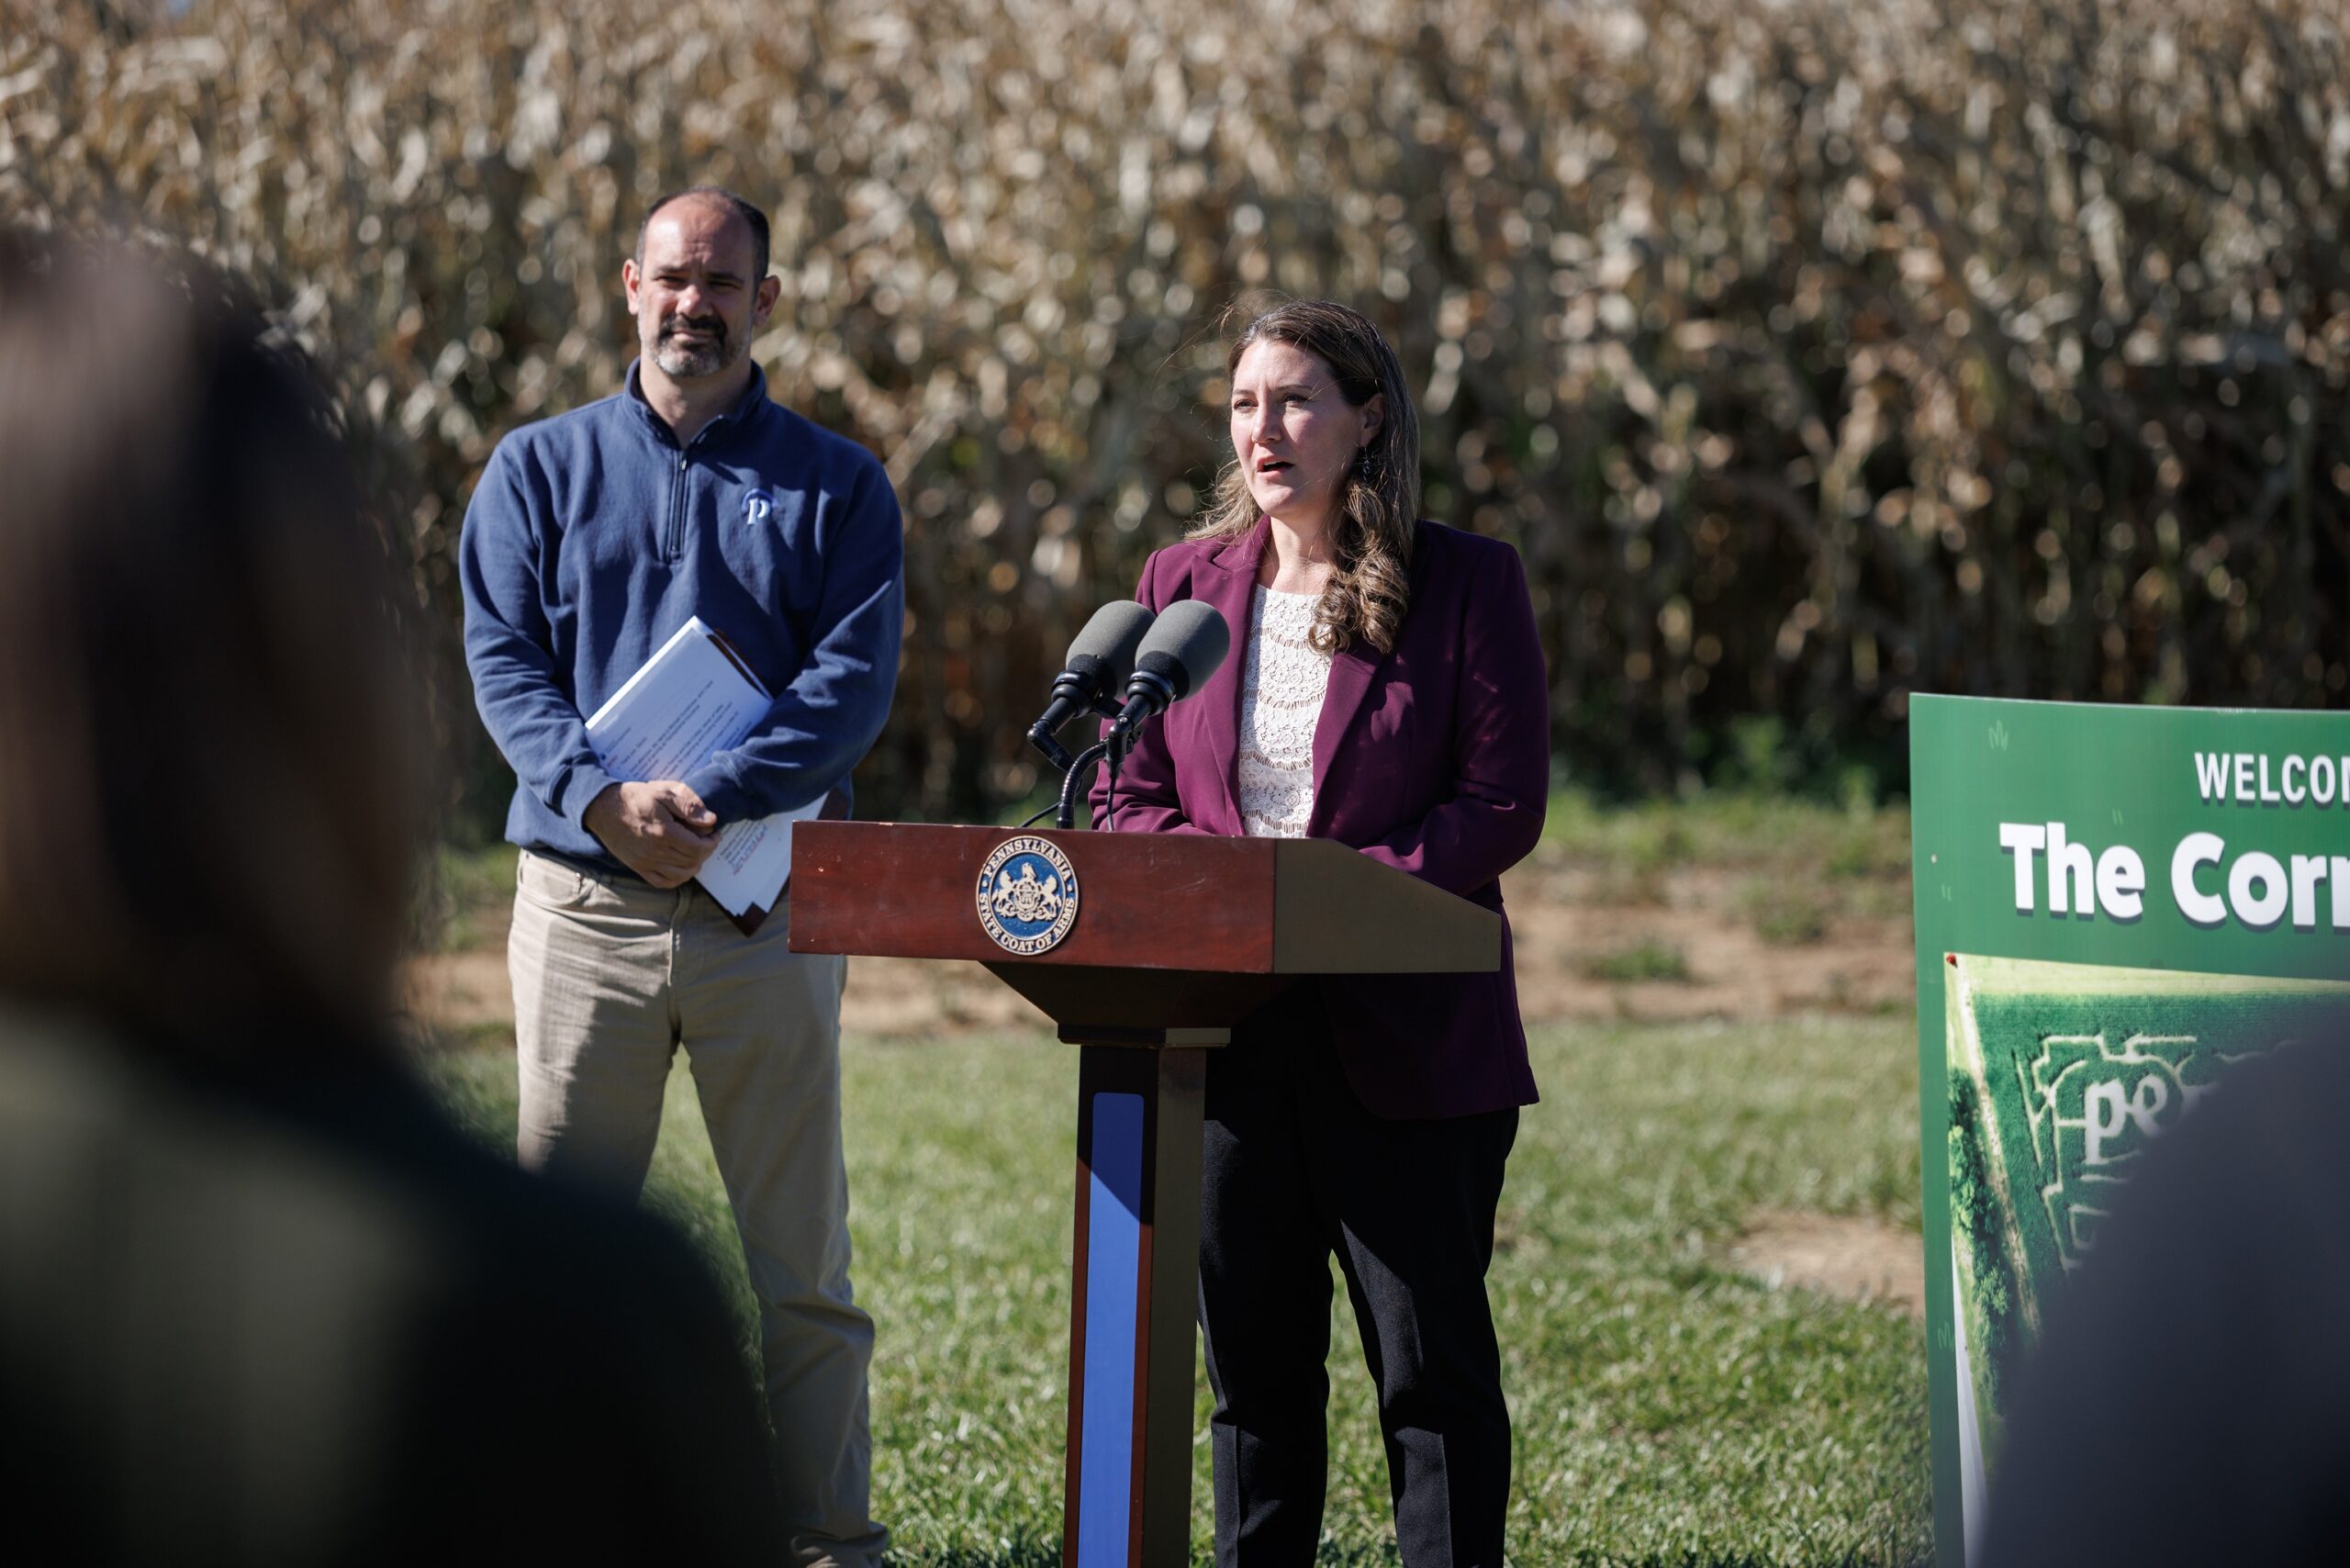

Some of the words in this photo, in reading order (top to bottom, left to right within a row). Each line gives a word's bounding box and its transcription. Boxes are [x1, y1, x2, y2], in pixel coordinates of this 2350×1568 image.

[983, 839, 1071, 881] PENNSYLVANIA
[1998, 823, 2145, 918] The
[979, 893, 1001, 937] STATE
[1001, 936, 1035, 951] COAT
[1035, 935, 1052, 949] OF
[1054, 898, 1075, 936] ARMS
